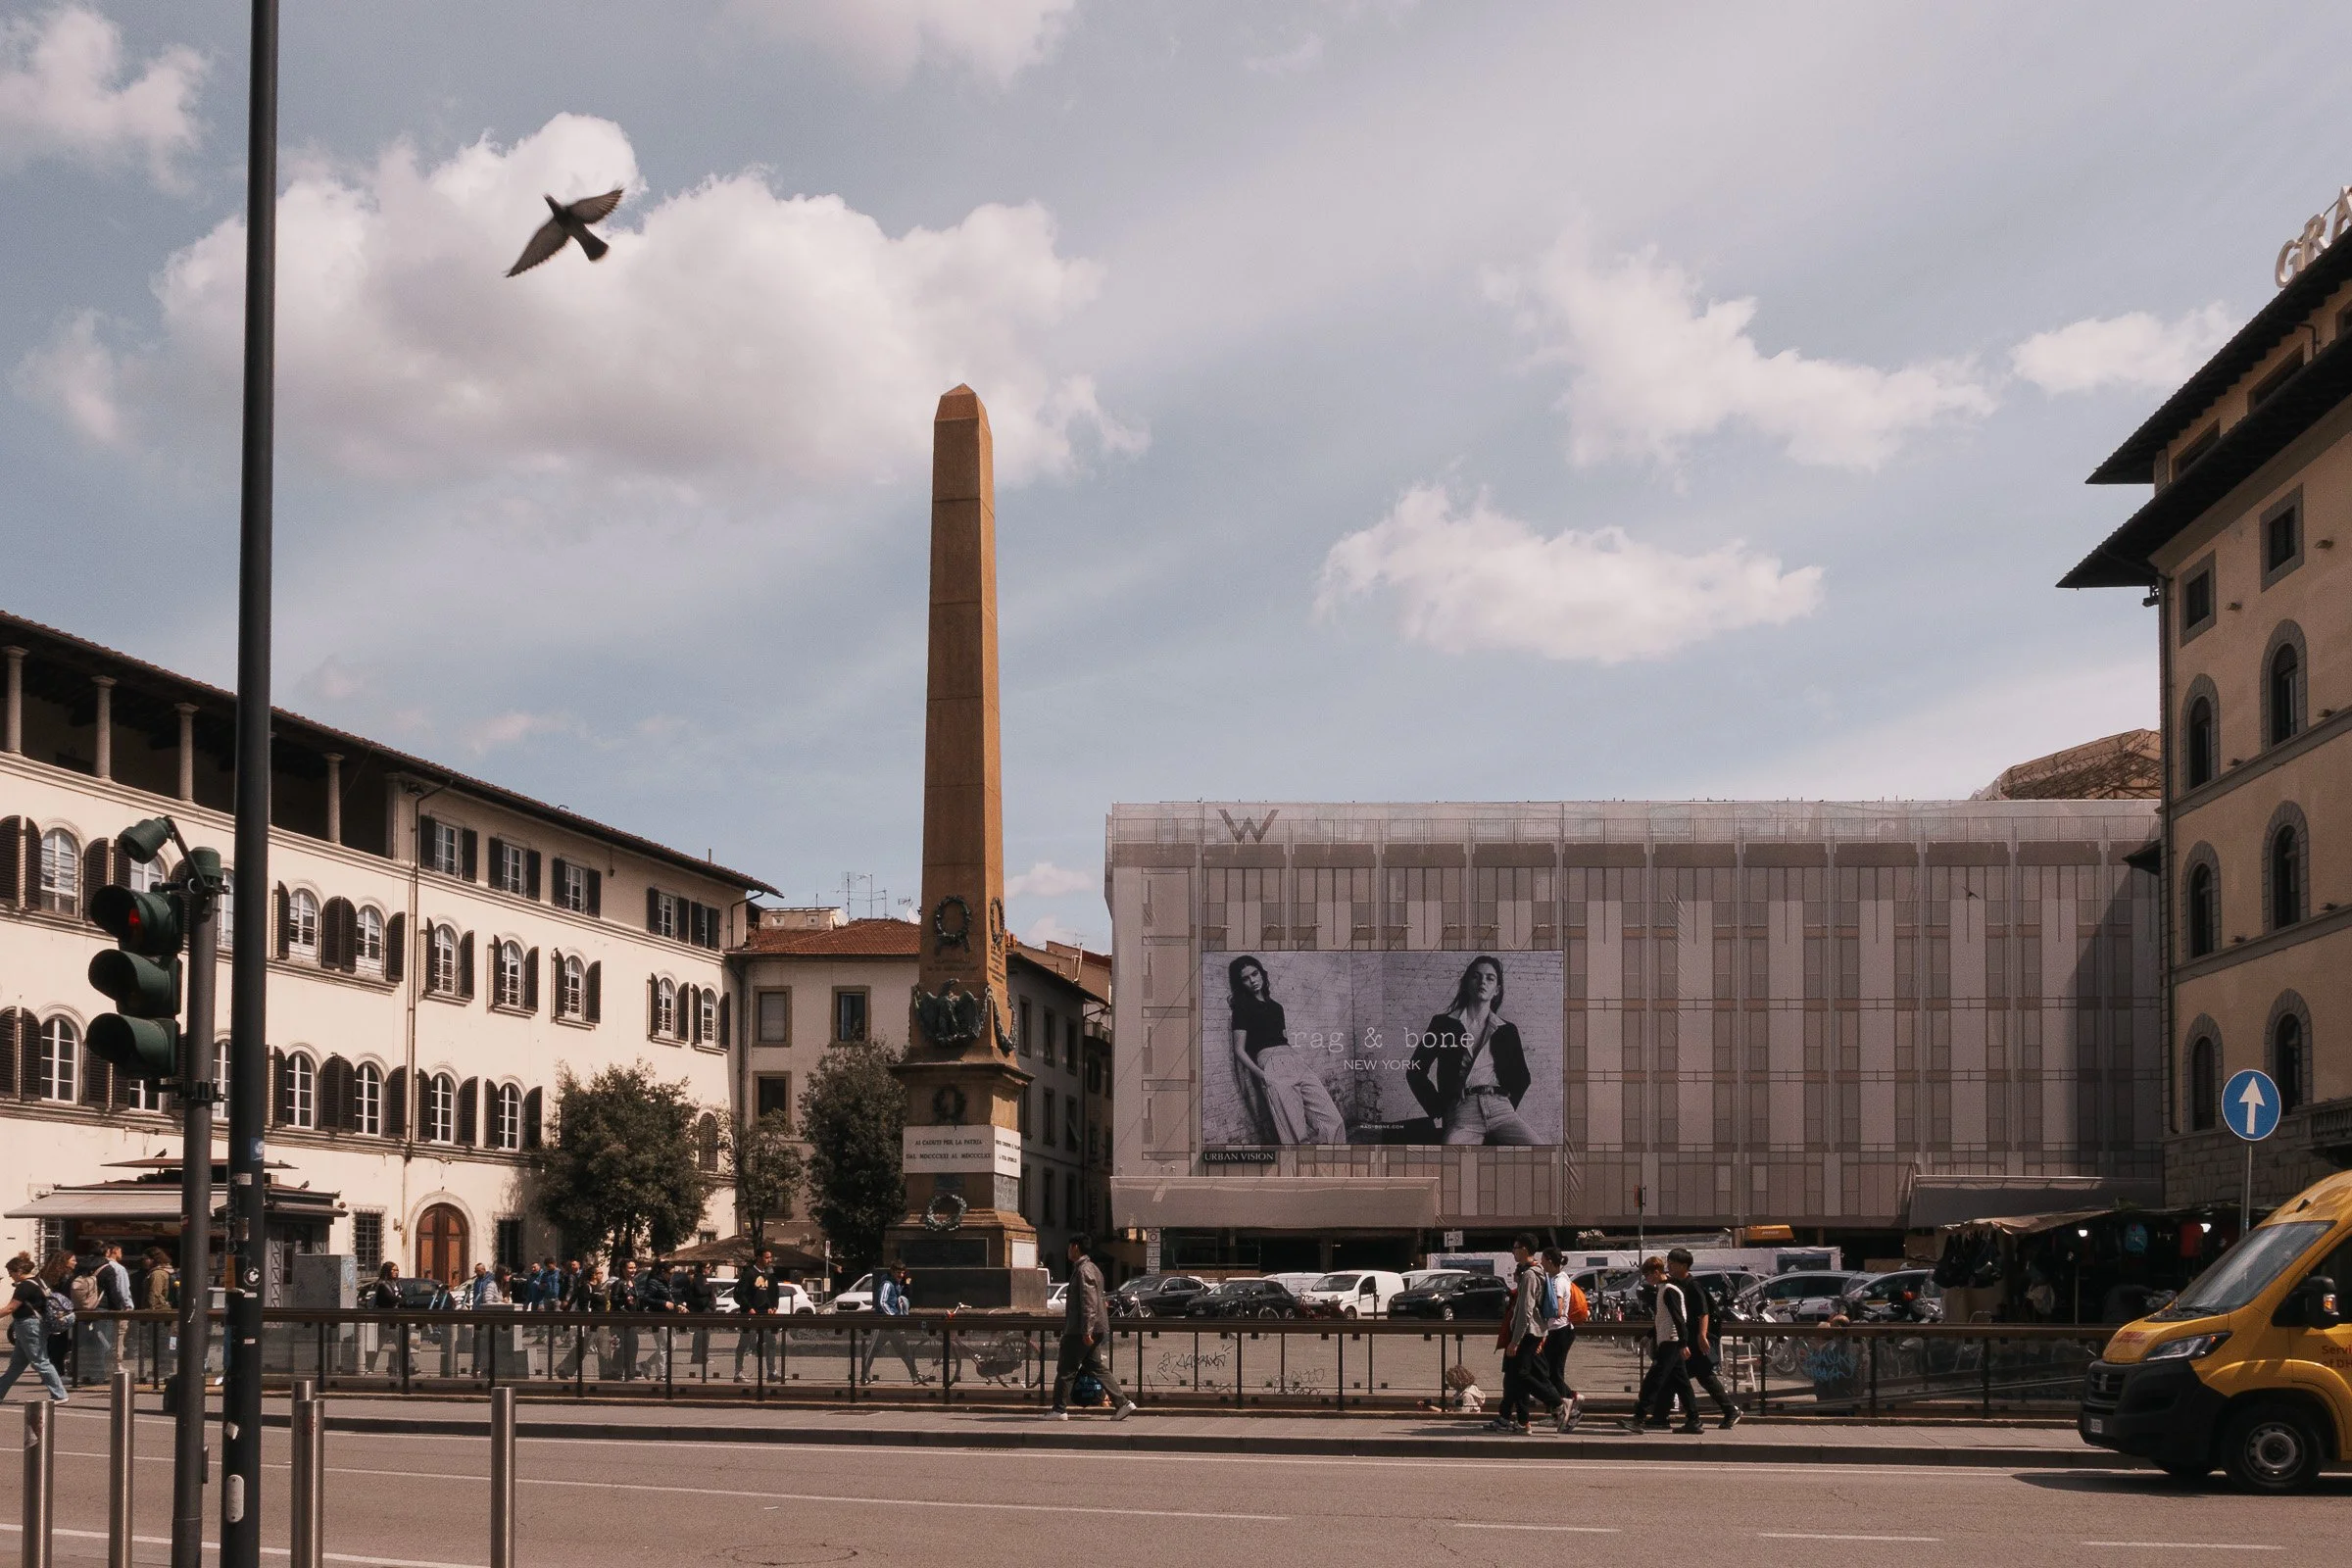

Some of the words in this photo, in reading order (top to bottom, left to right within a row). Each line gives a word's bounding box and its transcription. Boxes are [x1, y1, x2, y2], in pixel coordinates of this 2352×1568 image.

[1216, 808, 1280, 844] W
[1291, 1031, 1344, 1053] rag
[1364, 1026, 1383, 1049] &
[1403, 1027, 1475, 1049] bone
[1344, 1059, 1377, 1070] NEW
[1382, 1059, 1421, 1070] YORK
[2322, 1345, 2352, 1354] Servi
